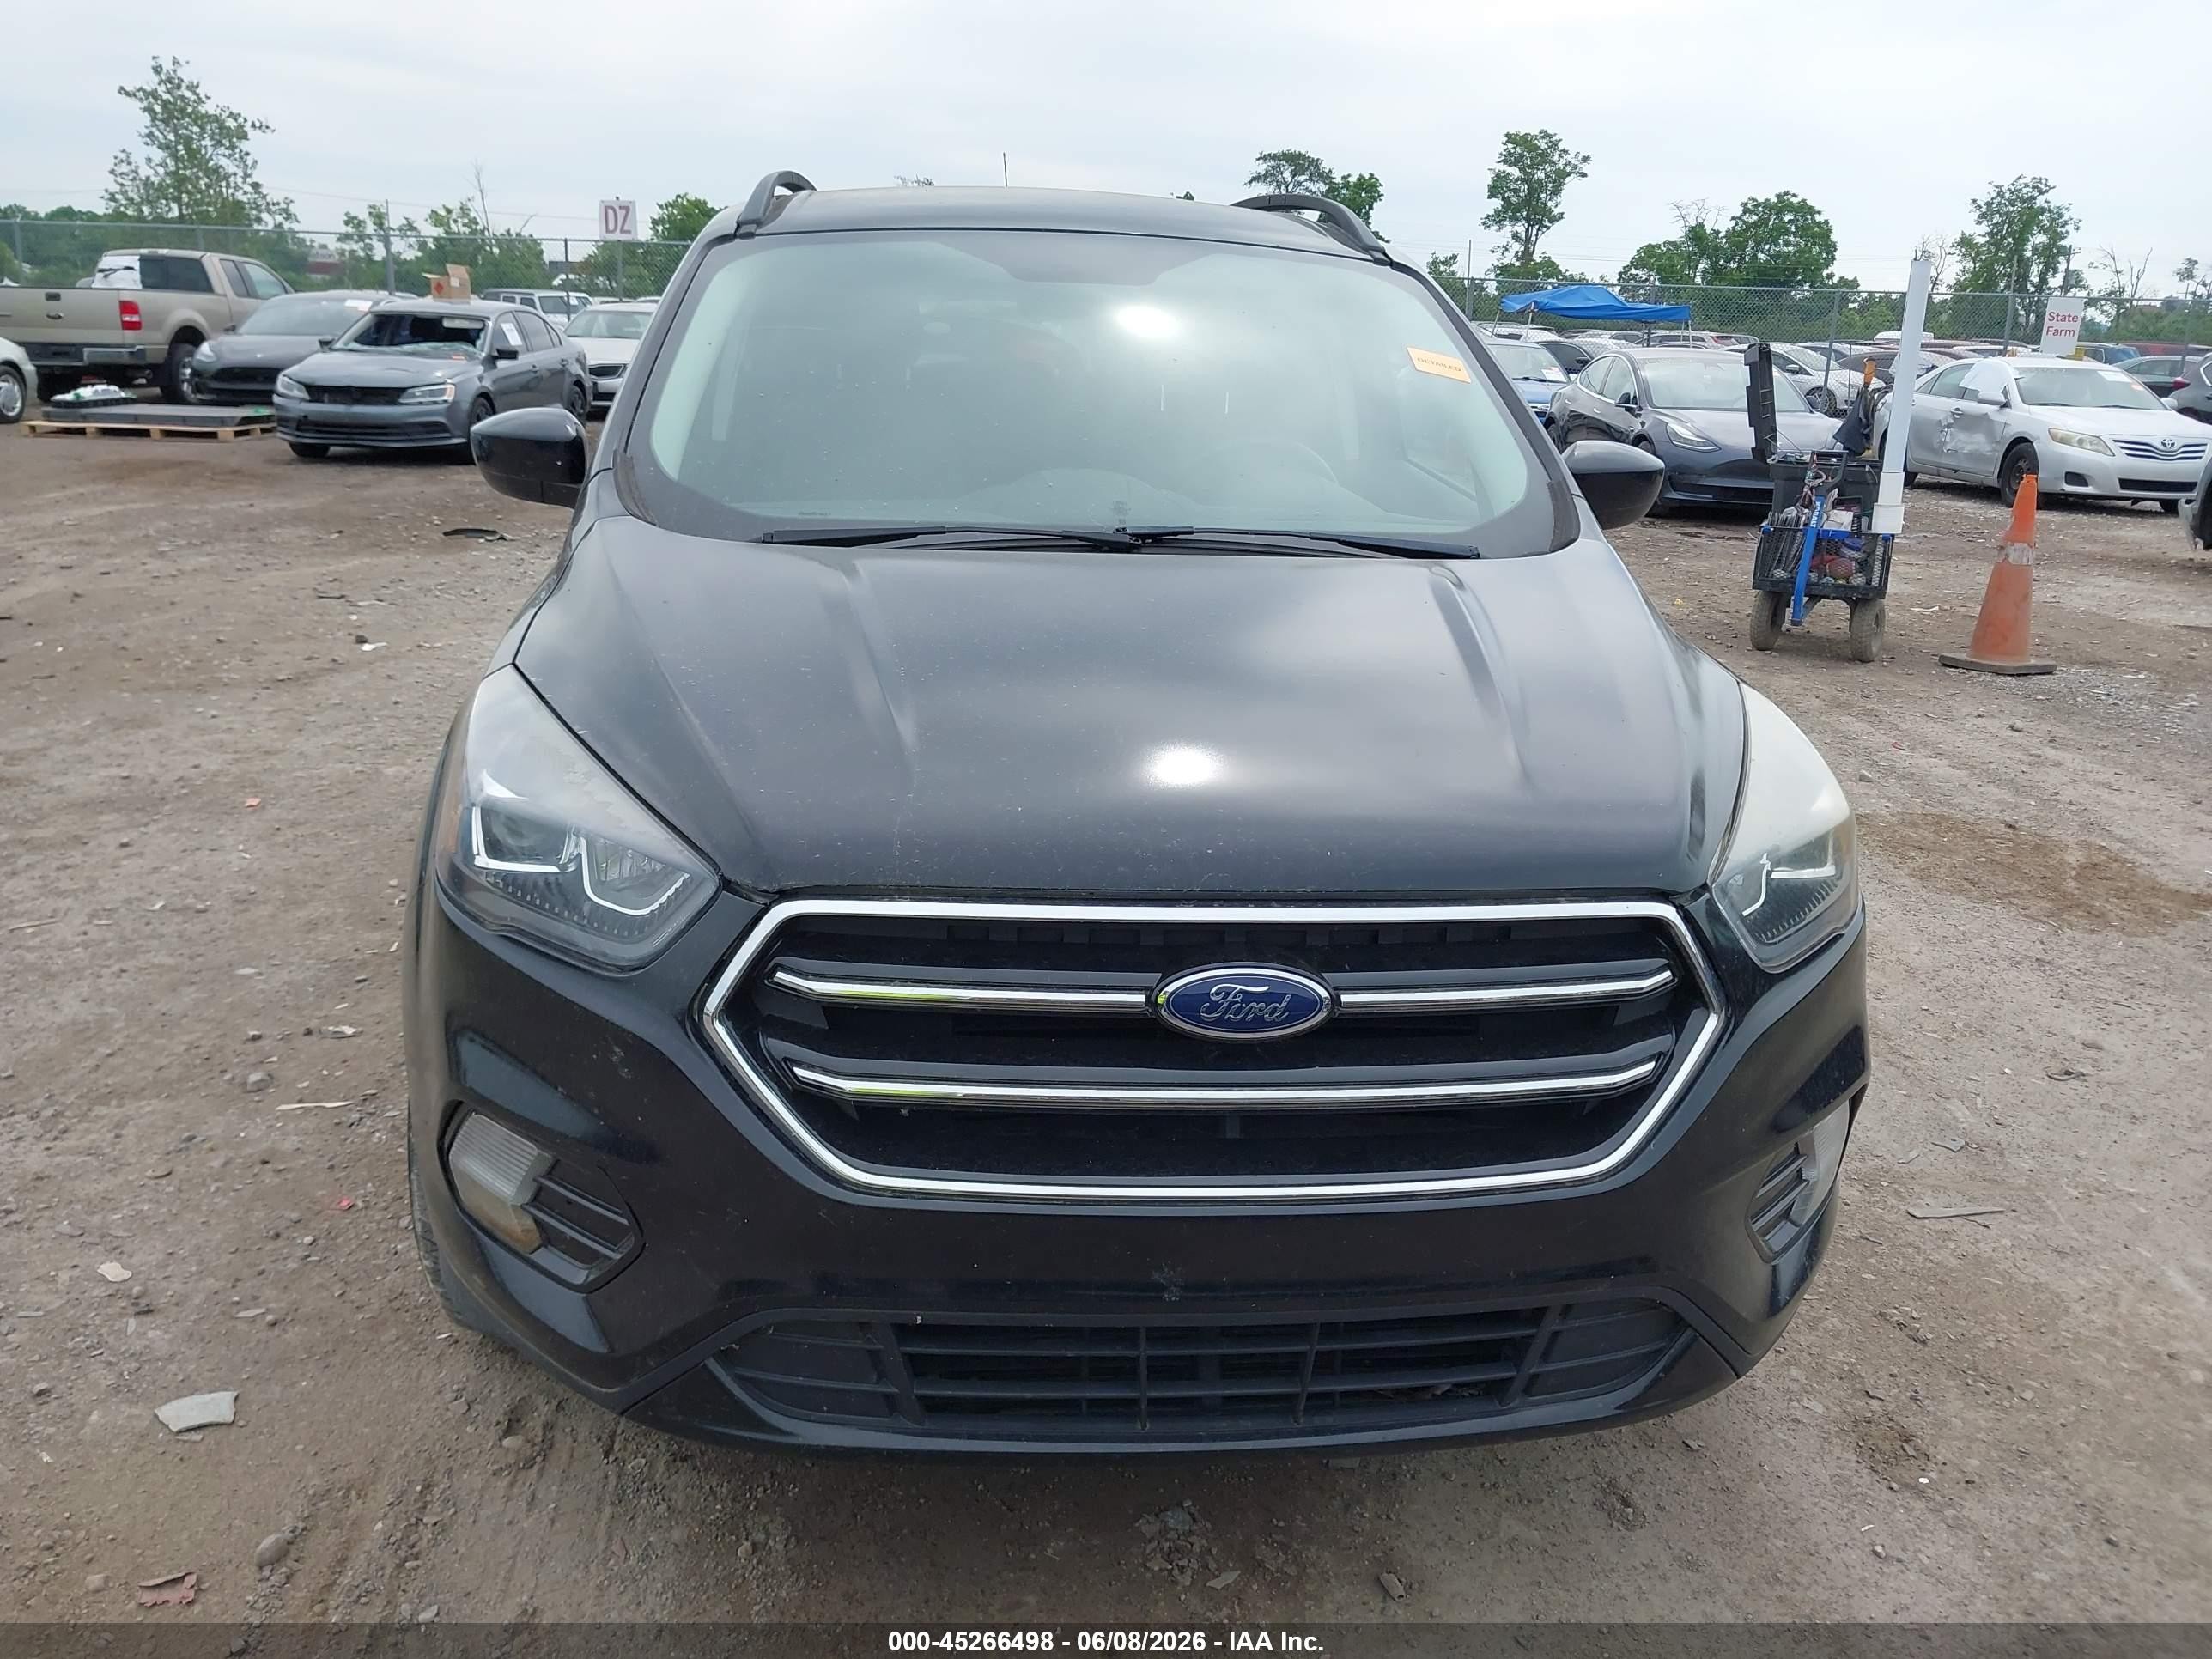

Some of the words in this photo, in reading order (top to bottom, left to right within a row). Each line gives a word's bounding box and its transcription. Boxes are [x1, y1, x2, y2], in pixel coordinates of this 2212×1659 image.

[604, 205, 632, 234] DZ
[2047, 311, 2079, 323] State
[2046, 325, 2075, 337] Farm
[1200, 983, 1292, 1022] Ford
